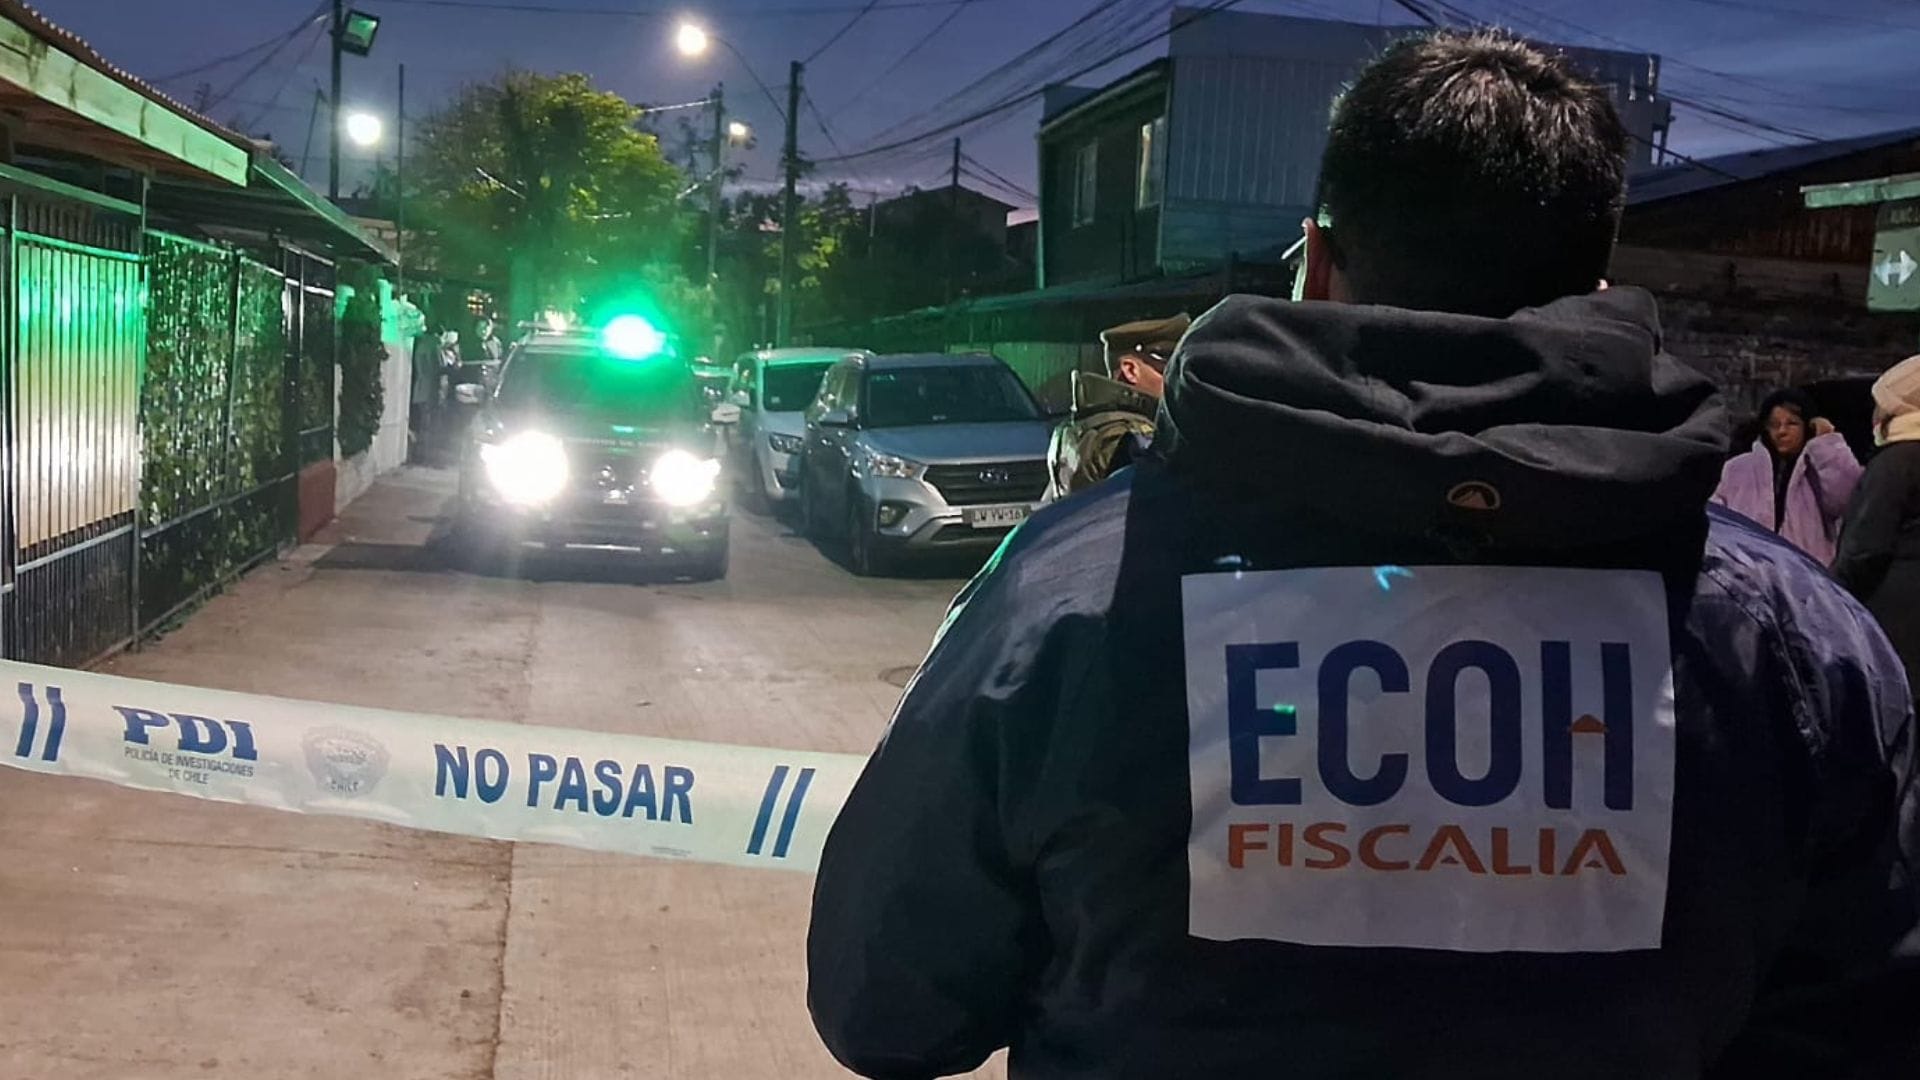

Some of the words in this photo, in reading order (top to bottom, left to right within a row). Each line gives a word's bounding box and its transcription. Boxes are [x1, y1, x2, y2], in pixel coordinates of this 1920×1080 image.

[112, 705, 258, 761] PDI
[1225, 640, 1634, 811] ECOH
[161, 752, 174, 766] DE
[175, 754, 254, 778] INVESTIGACIONES
[168, 767, 181, 781] DE
[183, 769, 209, 785] CHILE
[433, 743, 510, 804] NO
[526, 753, 695, 825] PASAR
[1227, 822, 1627, 876] FISCALIA
